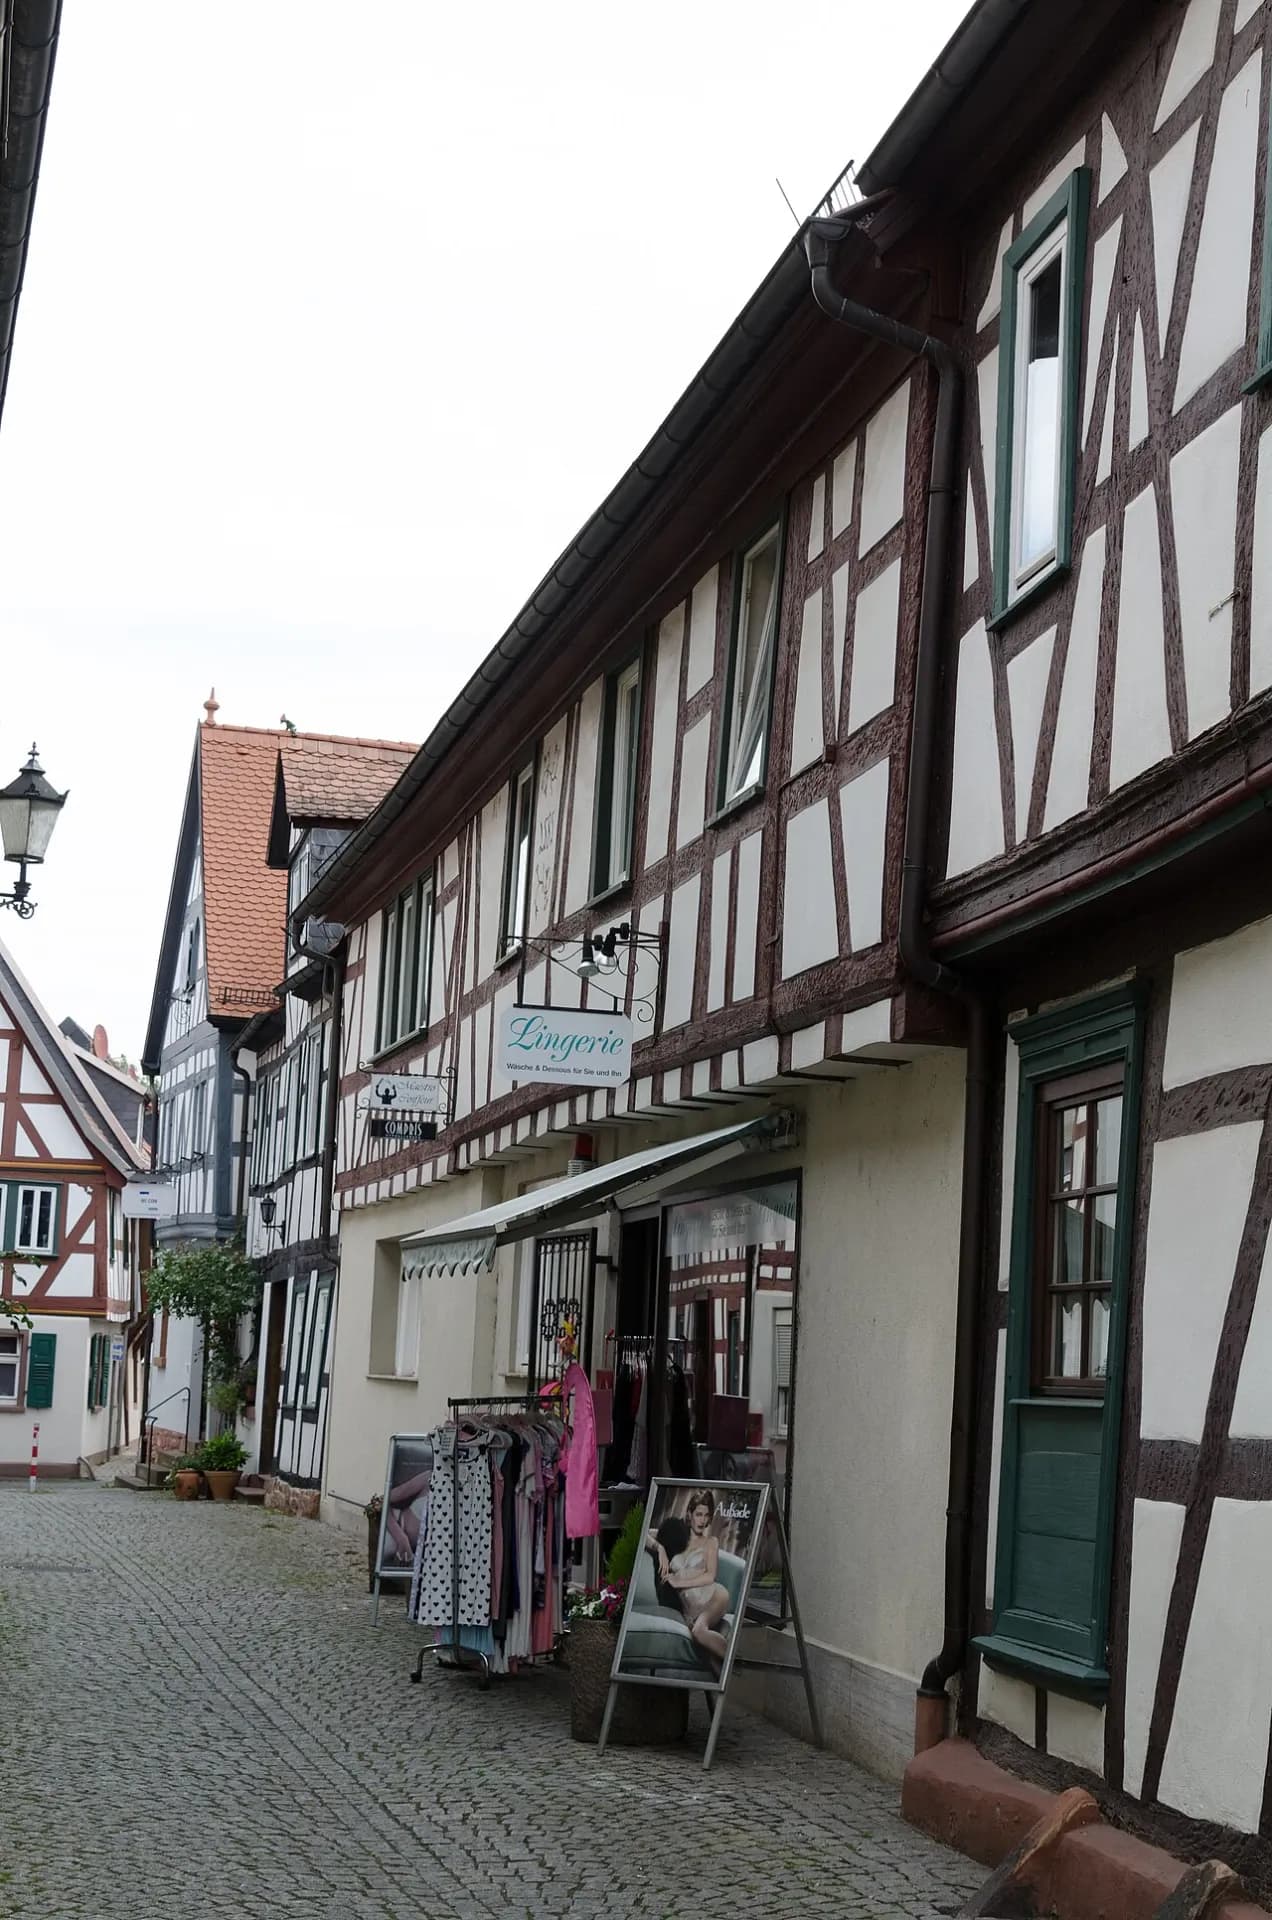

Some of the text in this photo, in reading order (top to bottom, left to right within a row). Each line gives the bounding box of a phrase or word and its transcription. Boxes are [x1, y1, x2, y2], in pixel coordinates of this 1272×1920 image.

[508, 1015, 624, 1063] Lingerie
[506, 1063, 534, 1071] Wäsche
[542, 1065, 571, 1073] Dessous
[573, 1066, 582, 1074] für
[713, 1501, 751, 1519] Aubade
